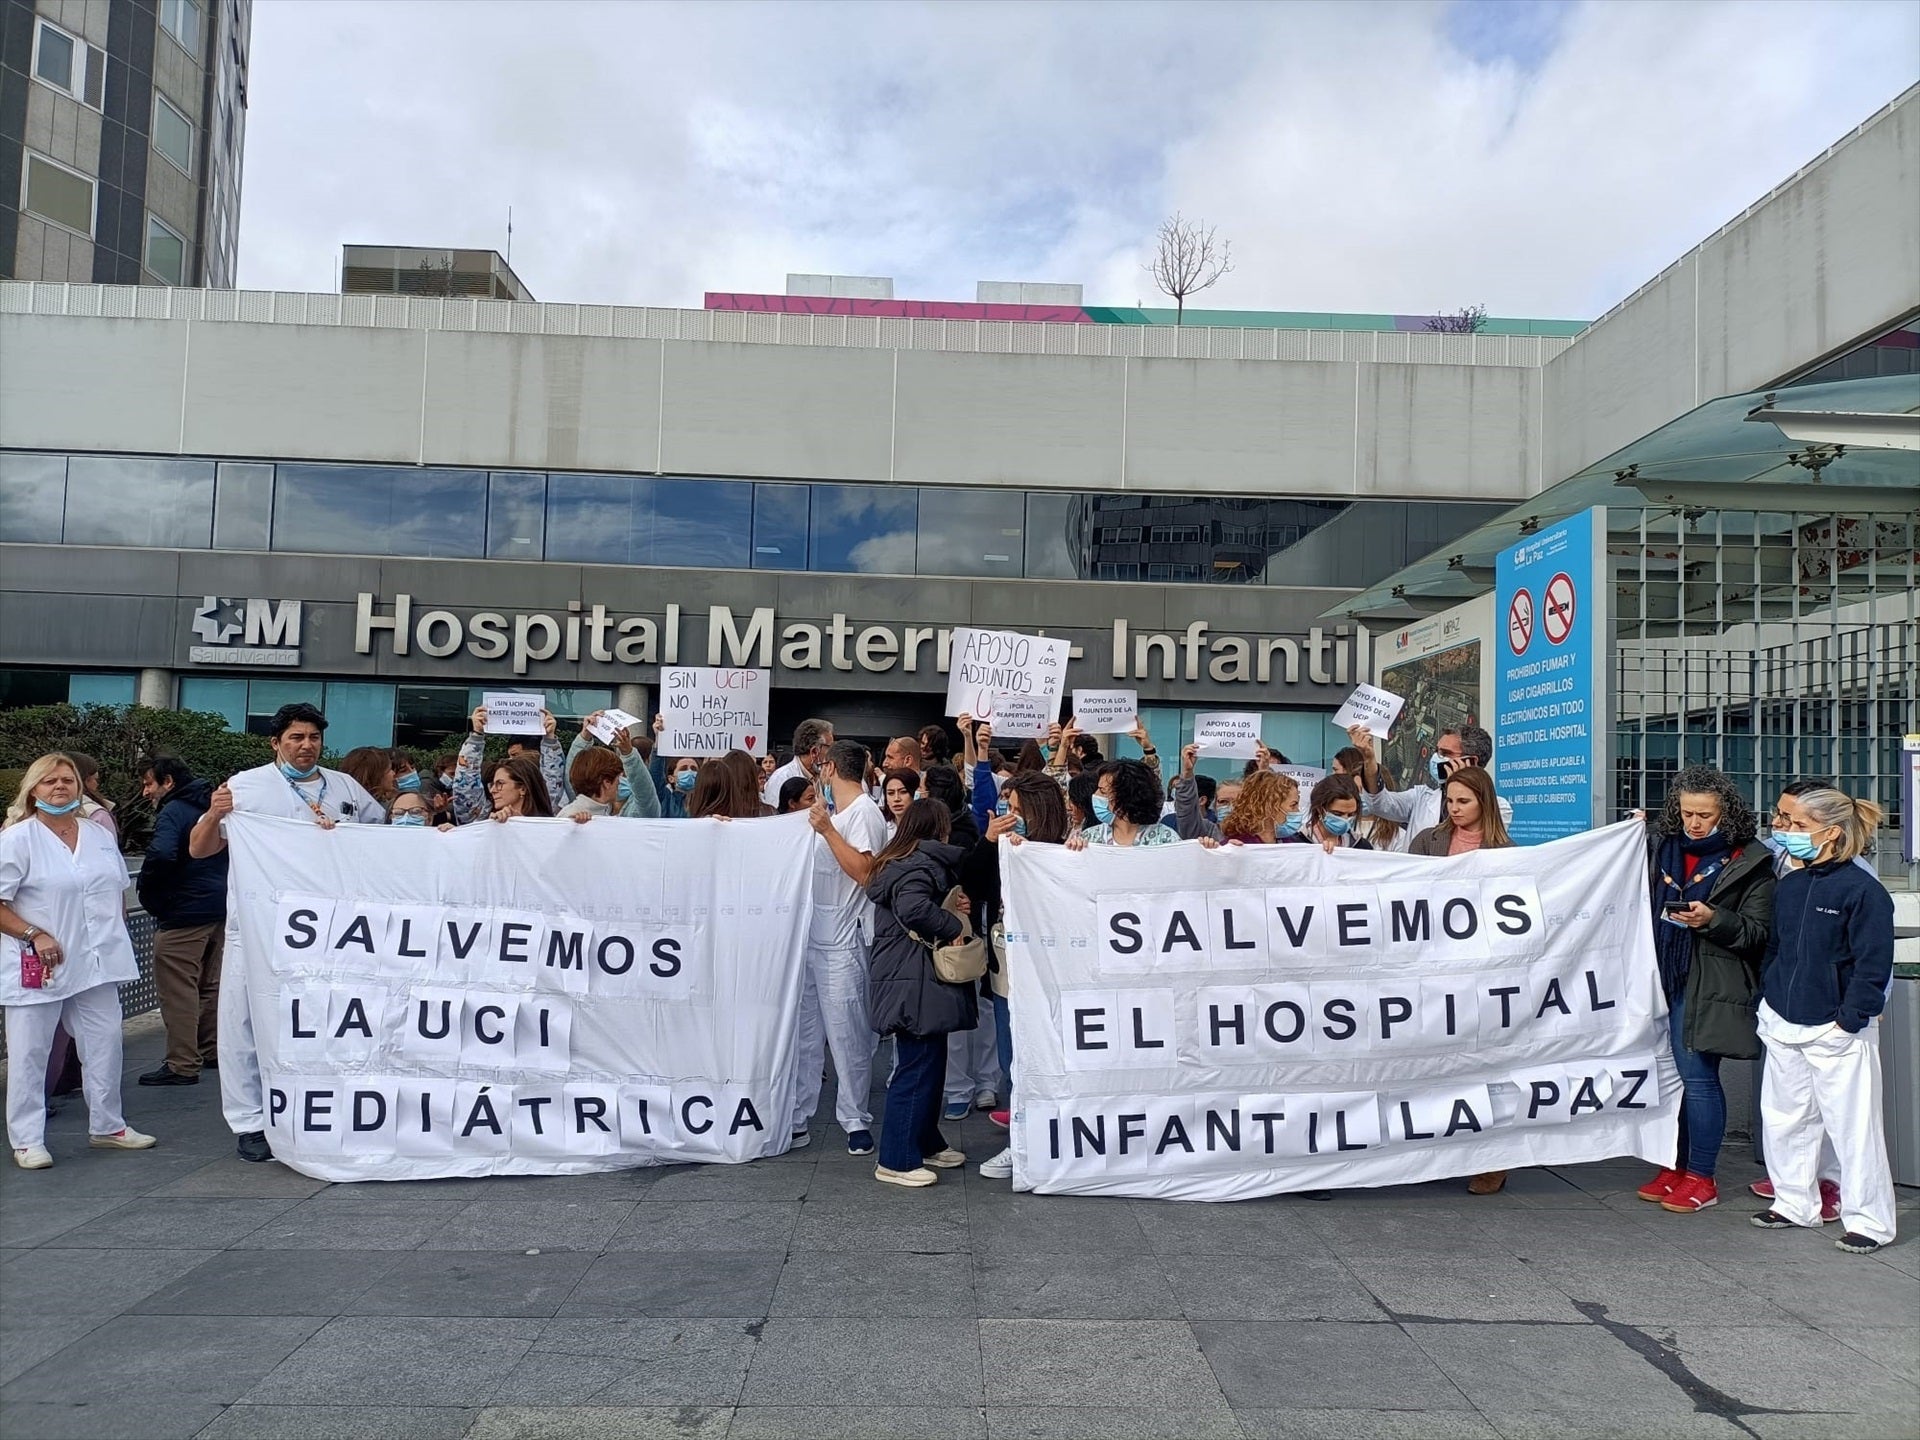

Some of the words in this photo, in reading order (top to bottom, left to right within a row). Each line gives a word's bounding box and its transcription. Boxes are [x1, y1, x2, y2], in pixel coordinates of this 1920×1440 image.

[1533, 550, 1543, 562] Paz
[355, 592, 679, 674] Hospital
[707, 605, 956, 673] Mater
[1112, 618, 1369, 684] Infantil
[964, 633, 1029, 667] APOYO
[1038, 656, 1056, 666] LOS
[1507, 662, 1540, 681] PROHIBIDO
[1542, 654, 1569, 672] FUMAR
[1570, 653, 1576, 666] Y
[960, 663, 1032, 693] ADJUNTOS
[1043, 686, 1054, 694] LA
[1509, 688, 1524, 702] USAR
[1526, 677, 1573, 698] CIGARRILLOS
[670, 694, 689, 709] NO
[703, 695, 728, 710] HAY
[1373, 708, 1382, 716] DE
[1378, 698, 1391, 708] LOS
[1501, 705, 1548, 726] ELECTRÓNICOS
[1549, 703, 1560, 717] EN
[1562, 698, 1584, 715] TODO
[996, 711, 1036, 719] REAPERTURA
[1353, 712, 1369, 720] UCIP
[1200, 730, 1236, 738] ADJUNTOS
[1499, 735, 1506, 747] EL
[1507, 731, 1533, 745] RECINTO
[1534, 729, 1548, 742] DEL
[1550, 723, 1587, 741] HOSPITAL
[1500, 762, 1510, 772] ESTA
[1541, 759, 1549, 768] ES
[1549, 756, 1580, 768] APLICABLE
[1581, 755, 1586, 765] A
[1523, 777, 1547, 786] ESPACIOS
[1548, 776, 1559, 785] DEL
[1560, 774, 1587, 784] HOSPITAL
[1539, 793, 1544, 803] O
[1544, 792, 1577, 803] CUBIERTOS
[1109, 893, 1533, 955] SALVEMOS
[285, 909, 682, 978] SALVEMOS
[1074, 1007, 1164, 1050] EL
[1210, 969, 1615, 1047] HOSPITAL
[291, 998, 373, 1039] LA
[418, 1000, 550, 1047] UCI
[270, 1086, 763, 1137] PEDIÁTRICA
[1049, 1107, 1368, 1160] INFANTIL
[1400, 1098, 1483, 1141] LA
[1527, 1069, 1649, 1120] PAZ
